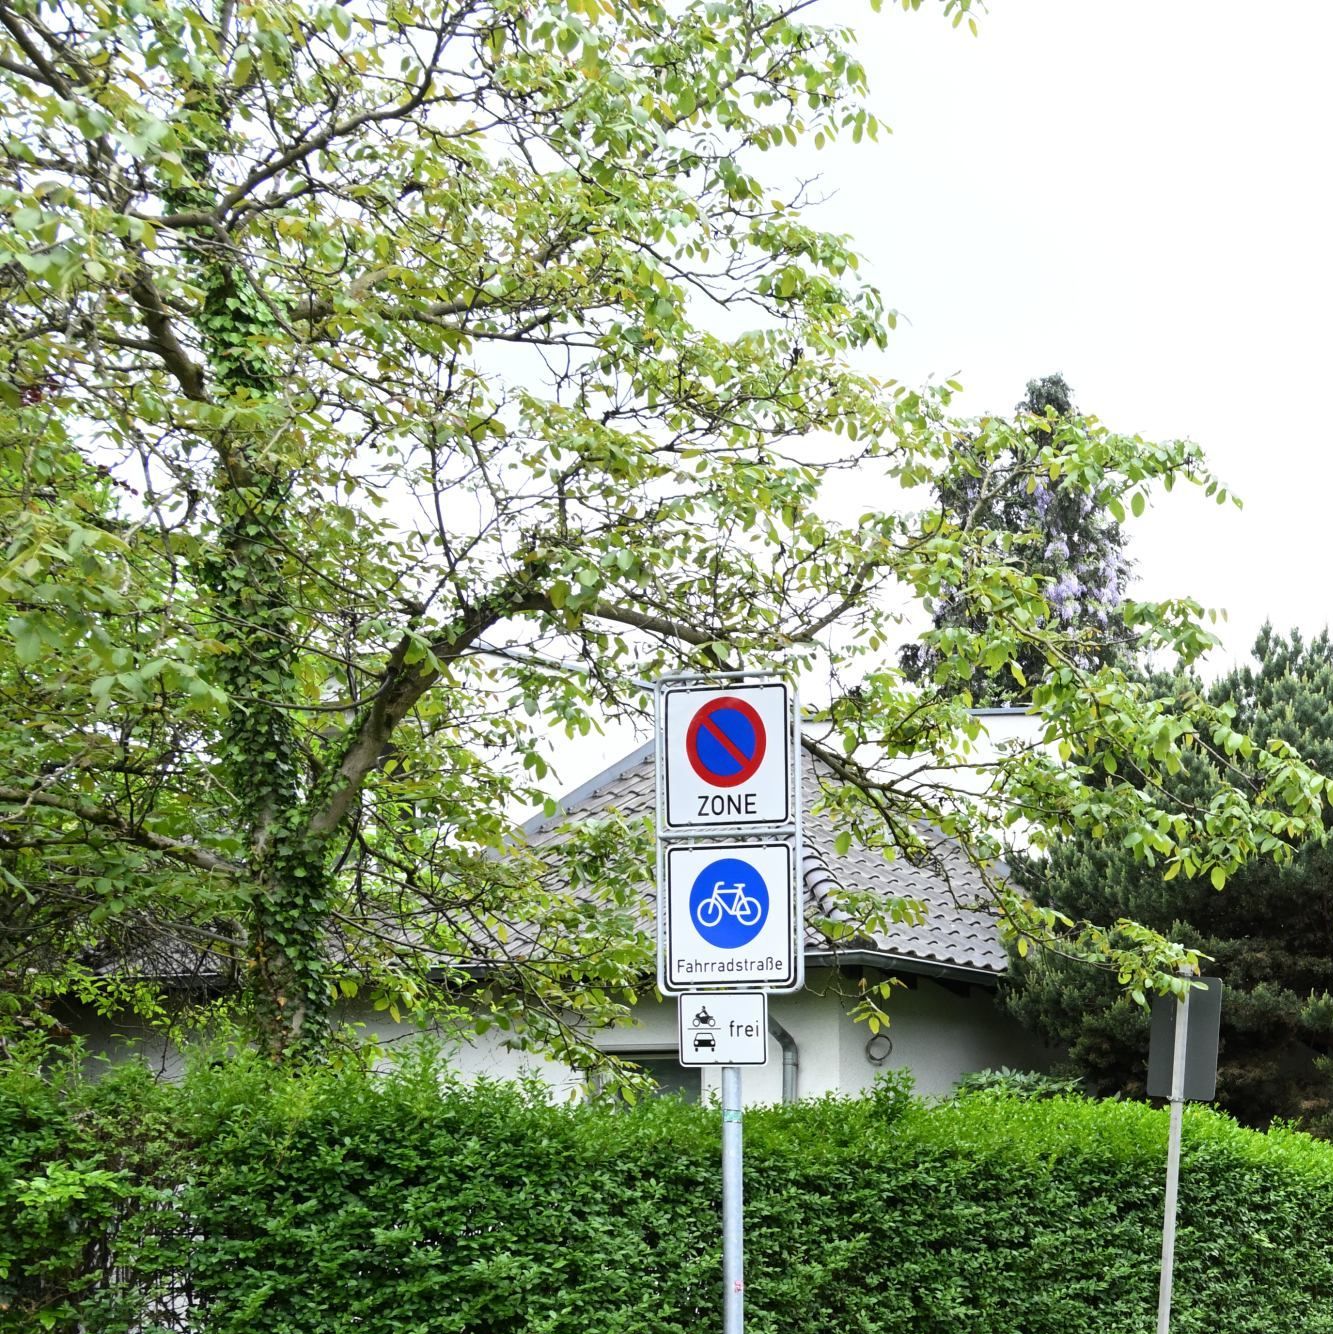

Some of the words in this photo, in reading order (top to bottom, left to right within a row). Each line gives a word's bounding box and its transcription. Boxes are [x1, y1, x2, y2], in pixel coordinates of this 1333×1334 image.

[697, 793, 757, 816] ZONE
[677, 956, 783, 974] Fahrradstraße
[729, 1020, 759, 1038] frei
